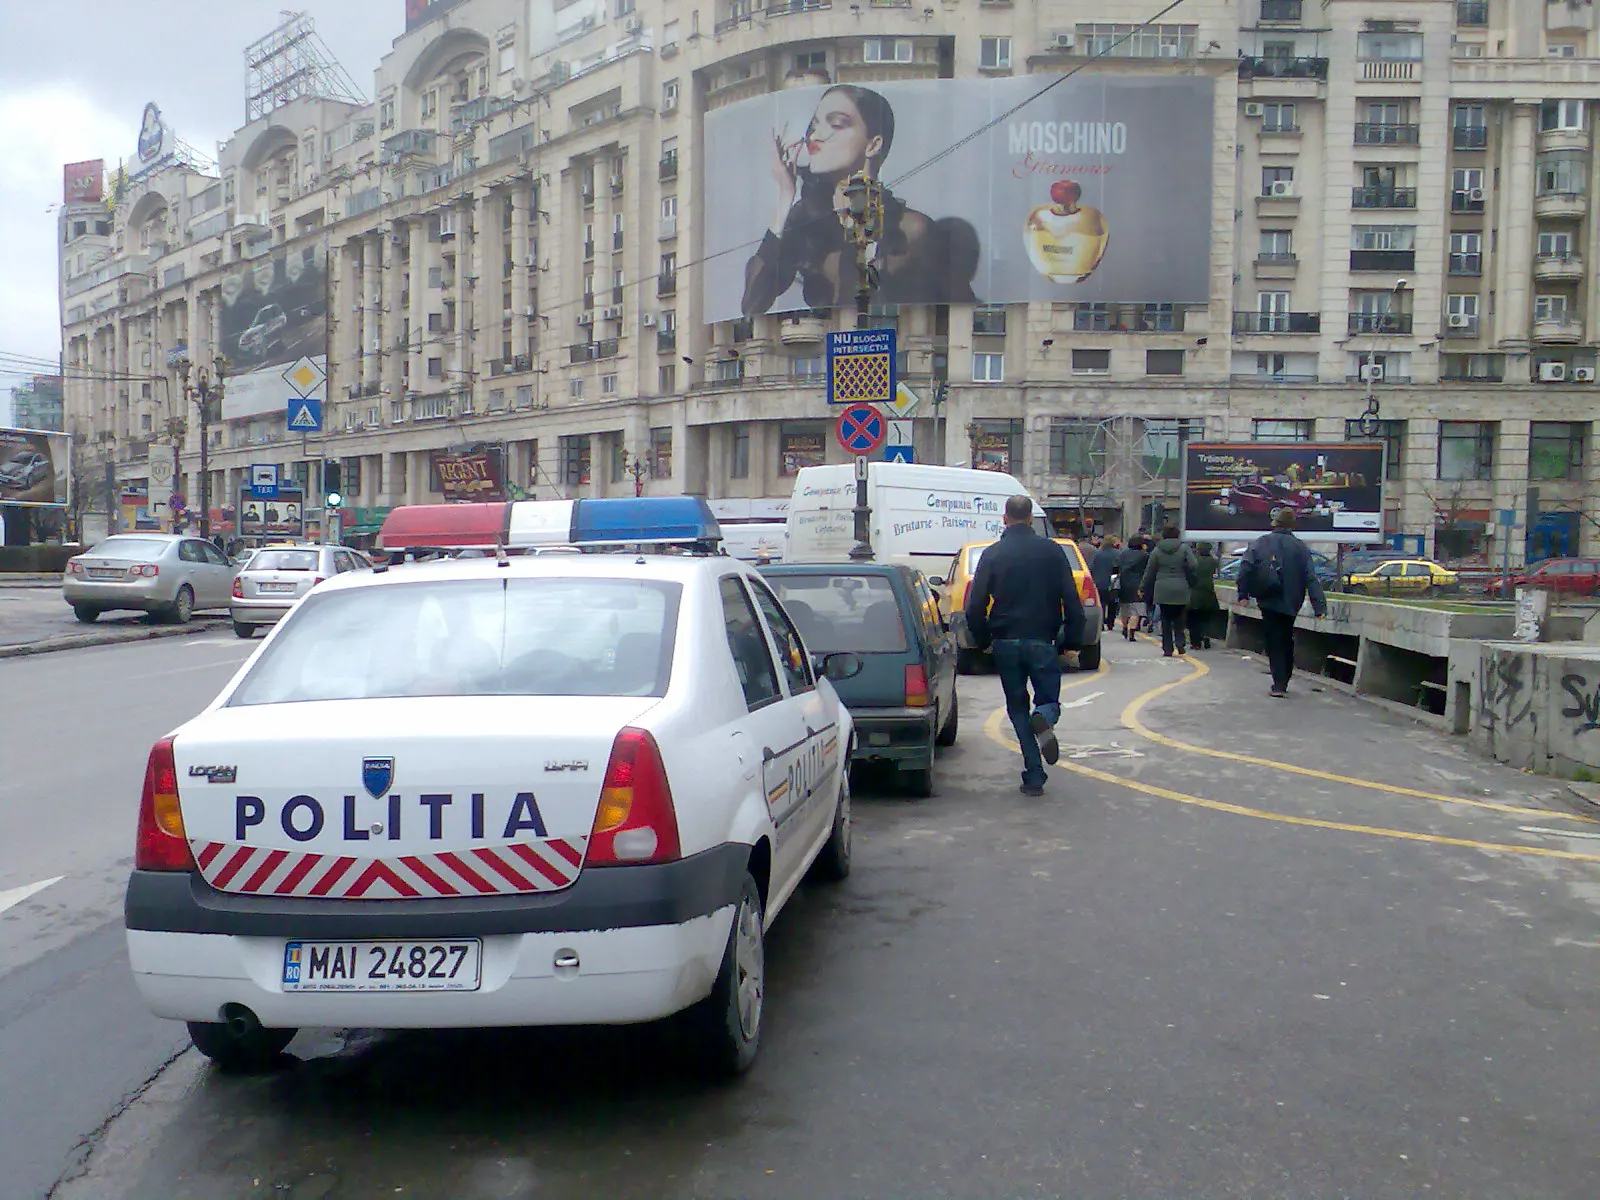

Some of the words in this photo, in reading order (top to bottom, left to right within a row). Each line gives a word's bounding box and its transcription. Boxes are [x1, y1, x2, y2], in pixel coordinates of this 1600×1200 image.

[1008, 121, 1128, 154] MOSCHINO
[833, 333, 852, 344] NU
[438, 460, 486, 480] REGENT
[189, 765, 237, 777] LOGAN
[787, 738, 825, 805] POLITIA
[236, 792, 548, 842] POLITIA
[286, 966, 300, 979] RO
[308, 946, 357, 979] MAI
[368, 945, 469, 979] 24827
